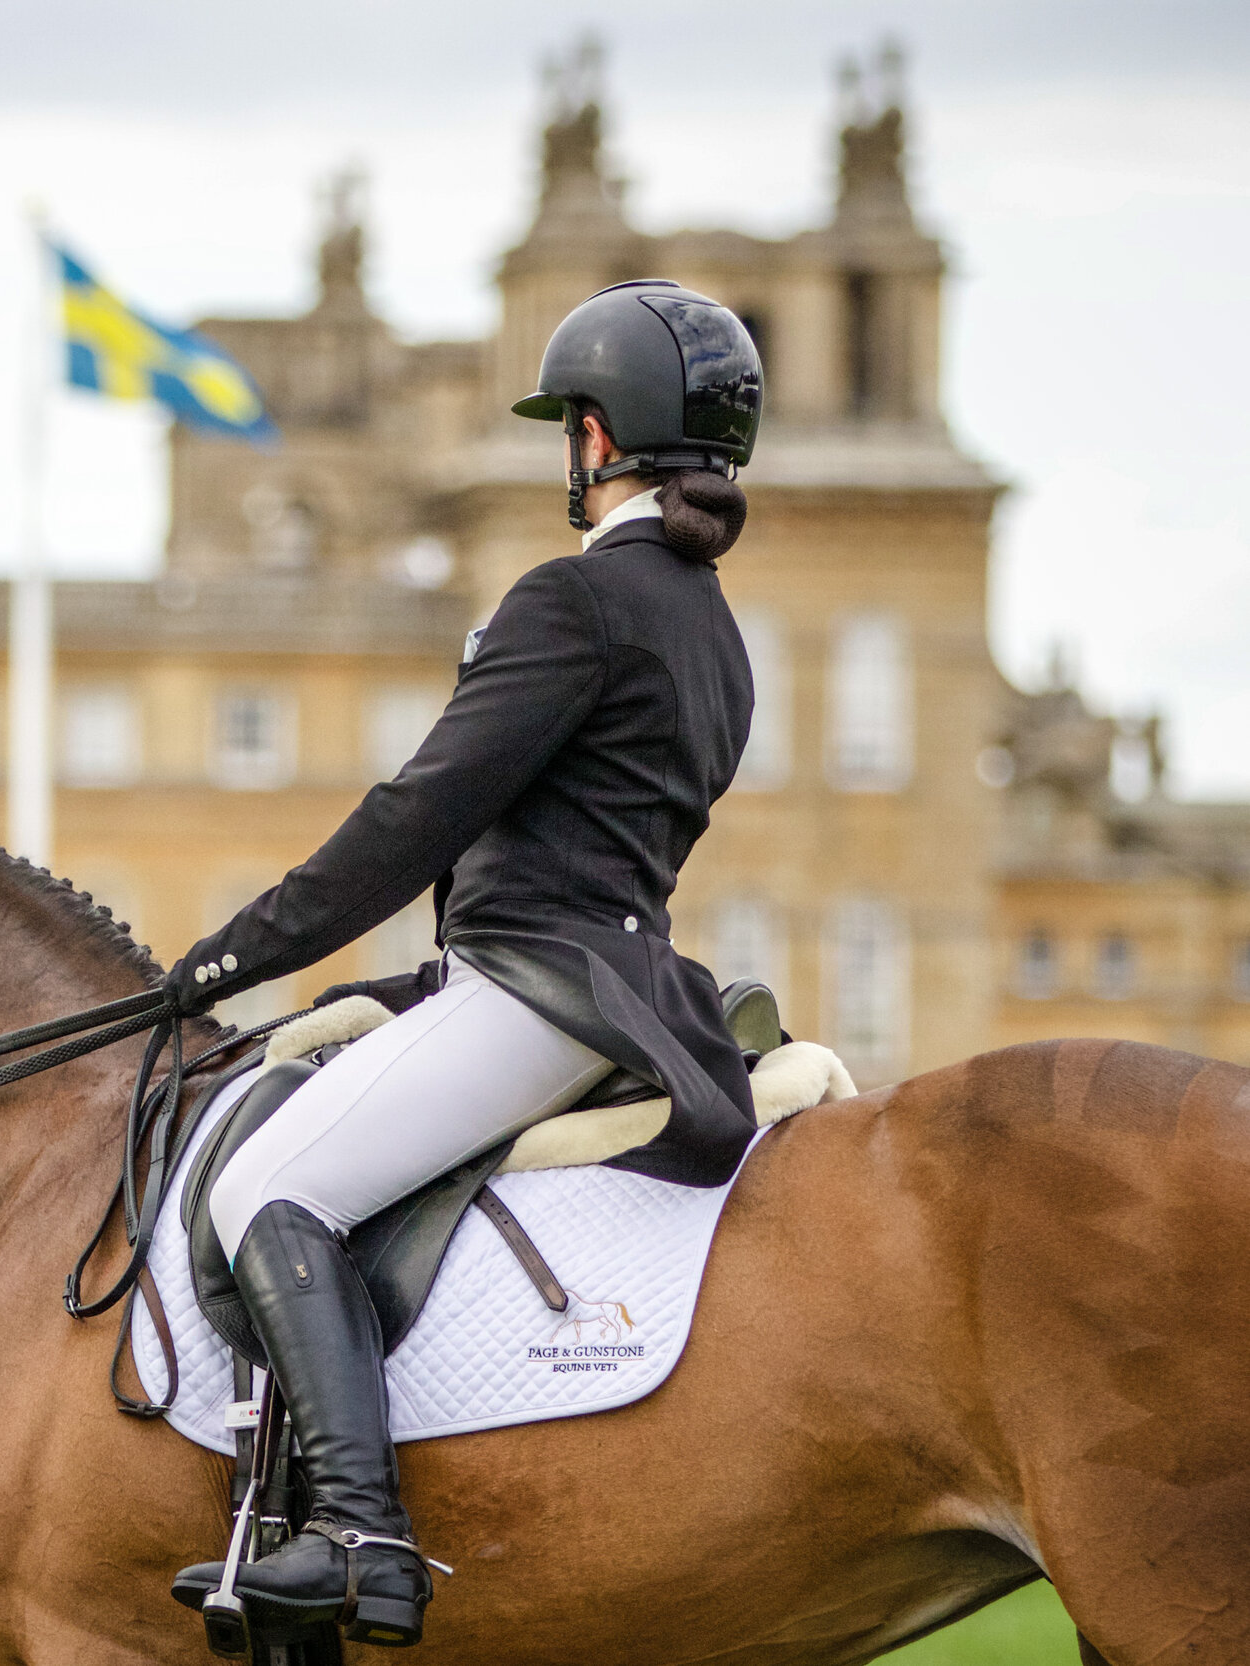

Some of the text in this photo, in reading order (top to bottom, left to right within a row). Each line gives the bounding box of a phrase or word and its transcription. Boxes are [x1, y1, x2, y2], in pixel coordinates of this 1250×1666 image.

[528, 1346, 645, 1358] PAGE & GUNSTONE
[553, 1362, 618, 1374] EQUINE VETS
